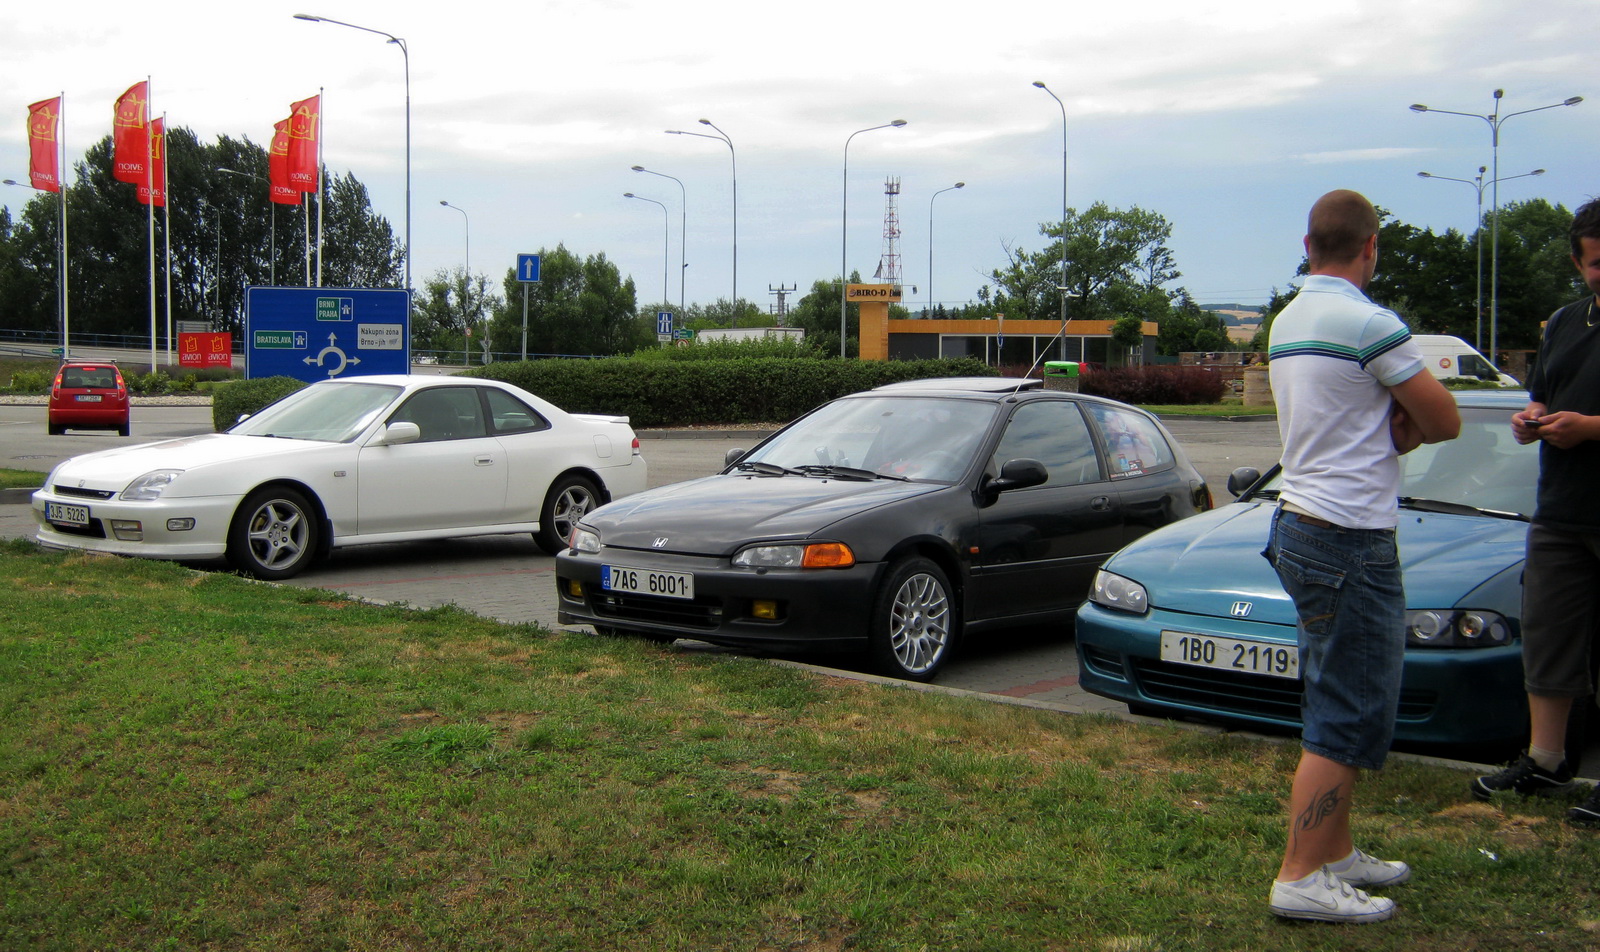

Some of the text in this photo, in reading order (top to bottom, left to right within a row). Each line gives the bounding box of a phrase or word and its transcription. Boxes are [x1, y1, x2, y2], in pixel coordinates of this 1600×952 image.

[856, 289, 887, 297] BIRO-D
[318, 300, 335, 308] BRNO
[318, 310, 338, 318] PRAHA
[385, 327, 399, 335] zóna
[256, 335, 292, 344] BRATISLAVA
[182, 353, 202, 361] avion
[208, 353, 228, 361] avion
[50, 505, 63, 519] 3J5
[67, 507, 86, 522] 5226
[612, 569, 685, 596] 7A6 6001
[1232, 643, 1289, 673] 2119
